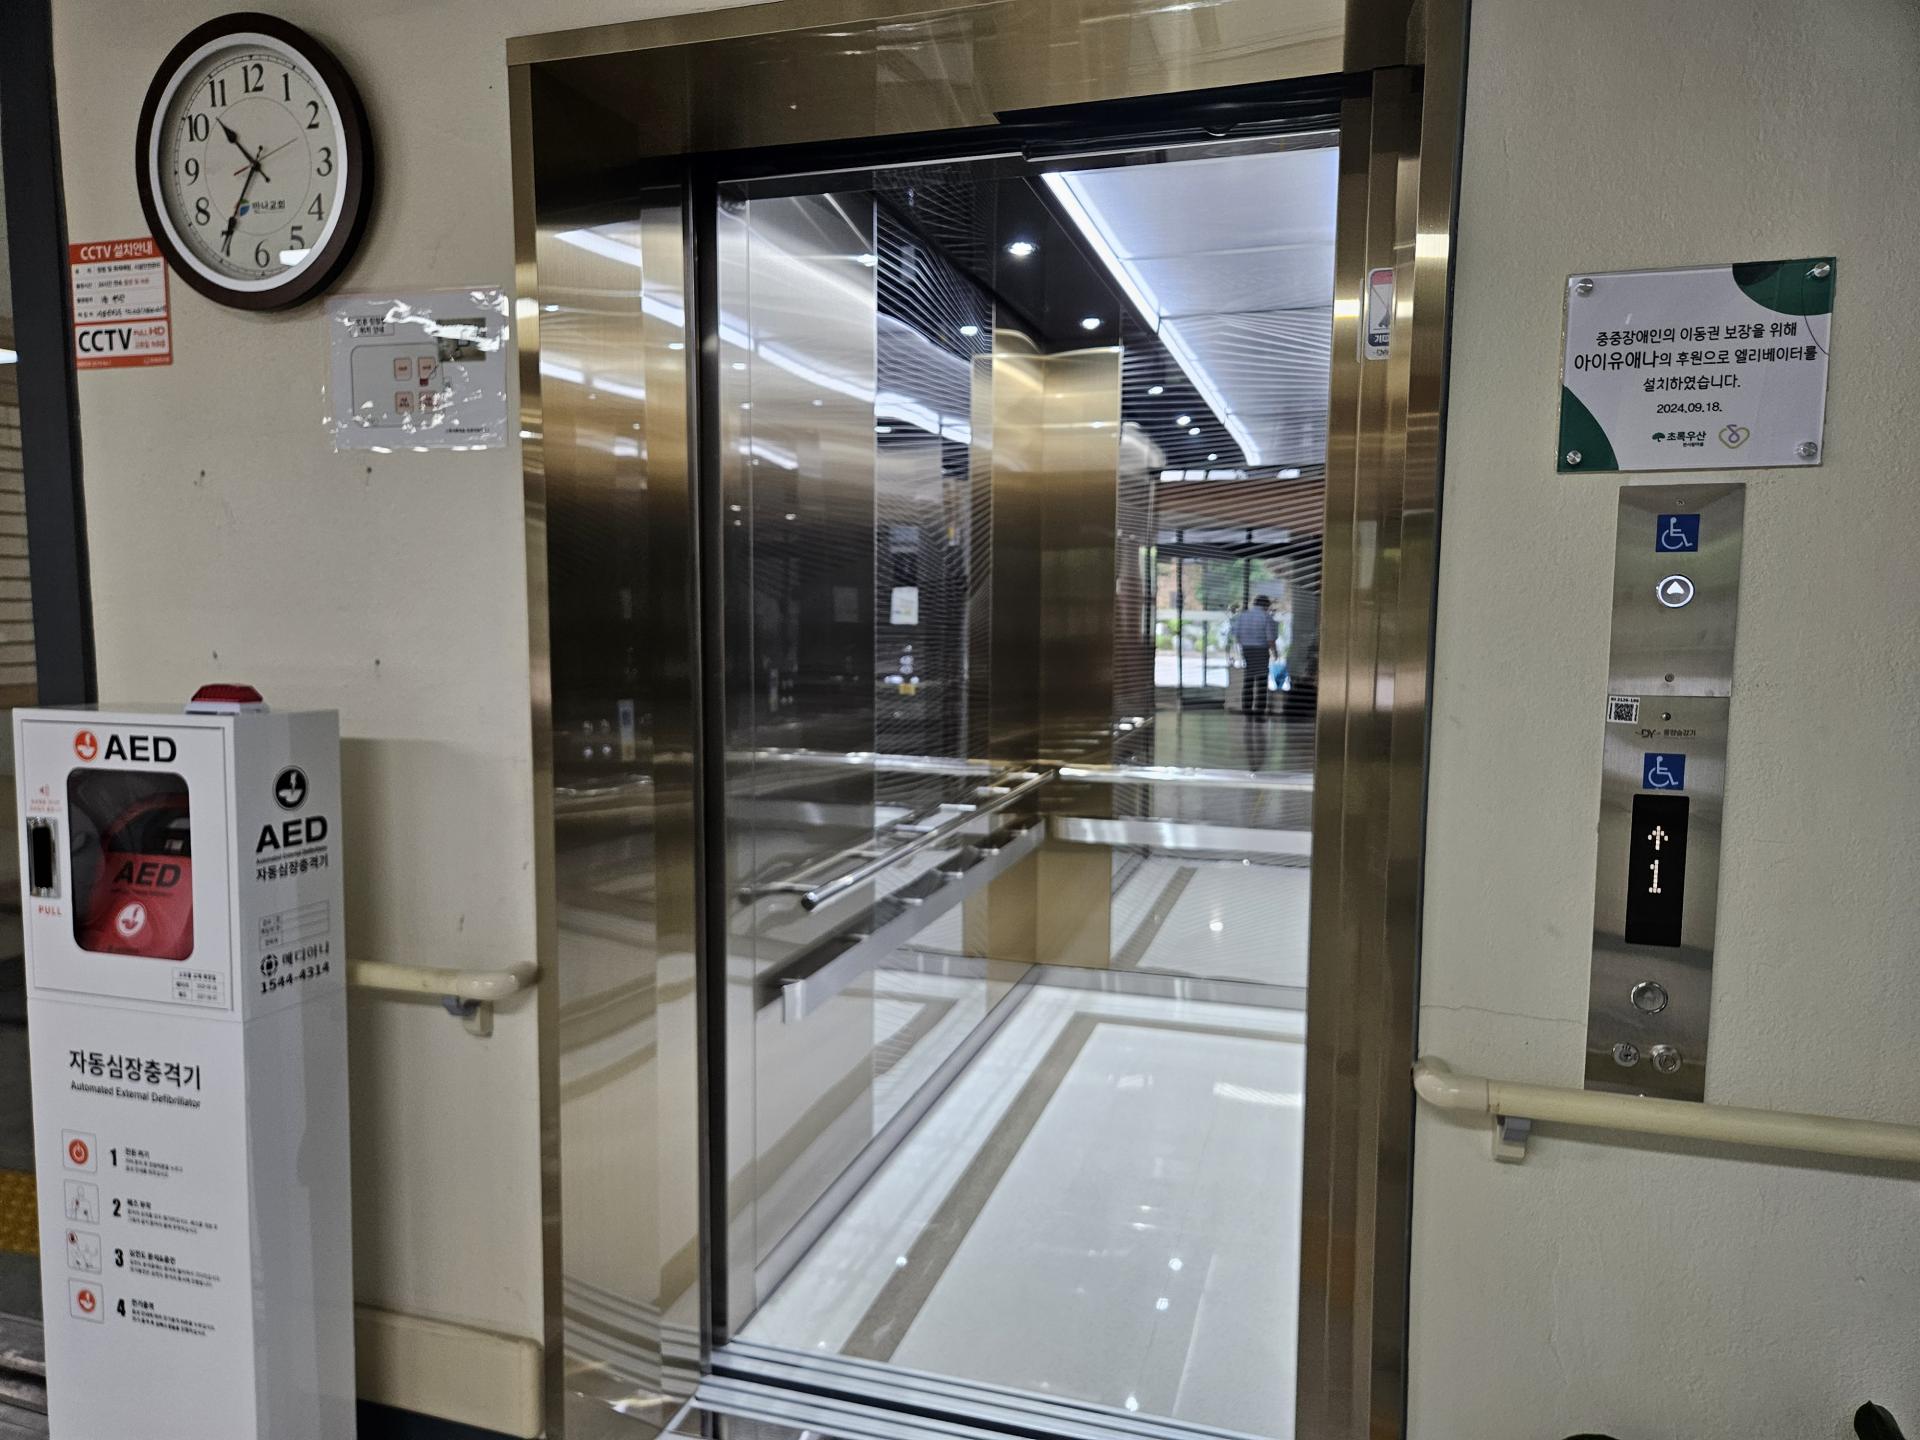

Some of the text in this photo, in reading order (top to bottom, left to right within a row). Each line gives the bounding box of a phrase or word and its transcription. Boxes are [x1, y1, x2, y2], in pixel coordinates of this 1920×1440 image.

[242, 63, 265, 93] 12
[282, 72, 291, 101] 1
[209, 79, 227, 107] 11
[187, 113, 209, 142] 10
[306, 100, 320, 129] 2
[185, 158, 199, 186] 9
[316, 147, 333, 177] 3
[195, 197, 210, 225] 8
[307, 192, 325, 221] 4
[80, 241, 153, 260] CCTV 설치안내
[221, 229, 233, 257] 7
[290, 225, 305, 250] 5
[255, 239, 270, 267] 6
[78, 327, 132, 352] CCTV
[1596, 322, 1797, 347] 중중장애인의 이동권 보장을 위해
[1574, 345, 1817, 372] 아이유애나의 후원으로 엘리베이터를
[1643, 374, 1741, 393] 설치하였습니다.
[1657, 402, 1722, 414] 2024.09.18.
[1667, 431, 1707, 442] 초록우산
[104, 734, 177, 763] AED
[256, 815, 328, 853] AED
[114, 861, 181, 889] AED
[1649, 859, 1662, 894] 1
[38, 905, 62, 916] PULL
[261, 961, 329, 994] 1544-4314
[69, 1049, 201, 1091] 자동심장충격기
[71, 1081, 114, 1096] Automated
[116, 1087, 149, 1102] External
[110, 1148, 117, 1166] 1
[113, 1198, 121, 1217] 2
[115, 1248, 124, 1267] 3
[117, 1298, 126, 1317] 4
